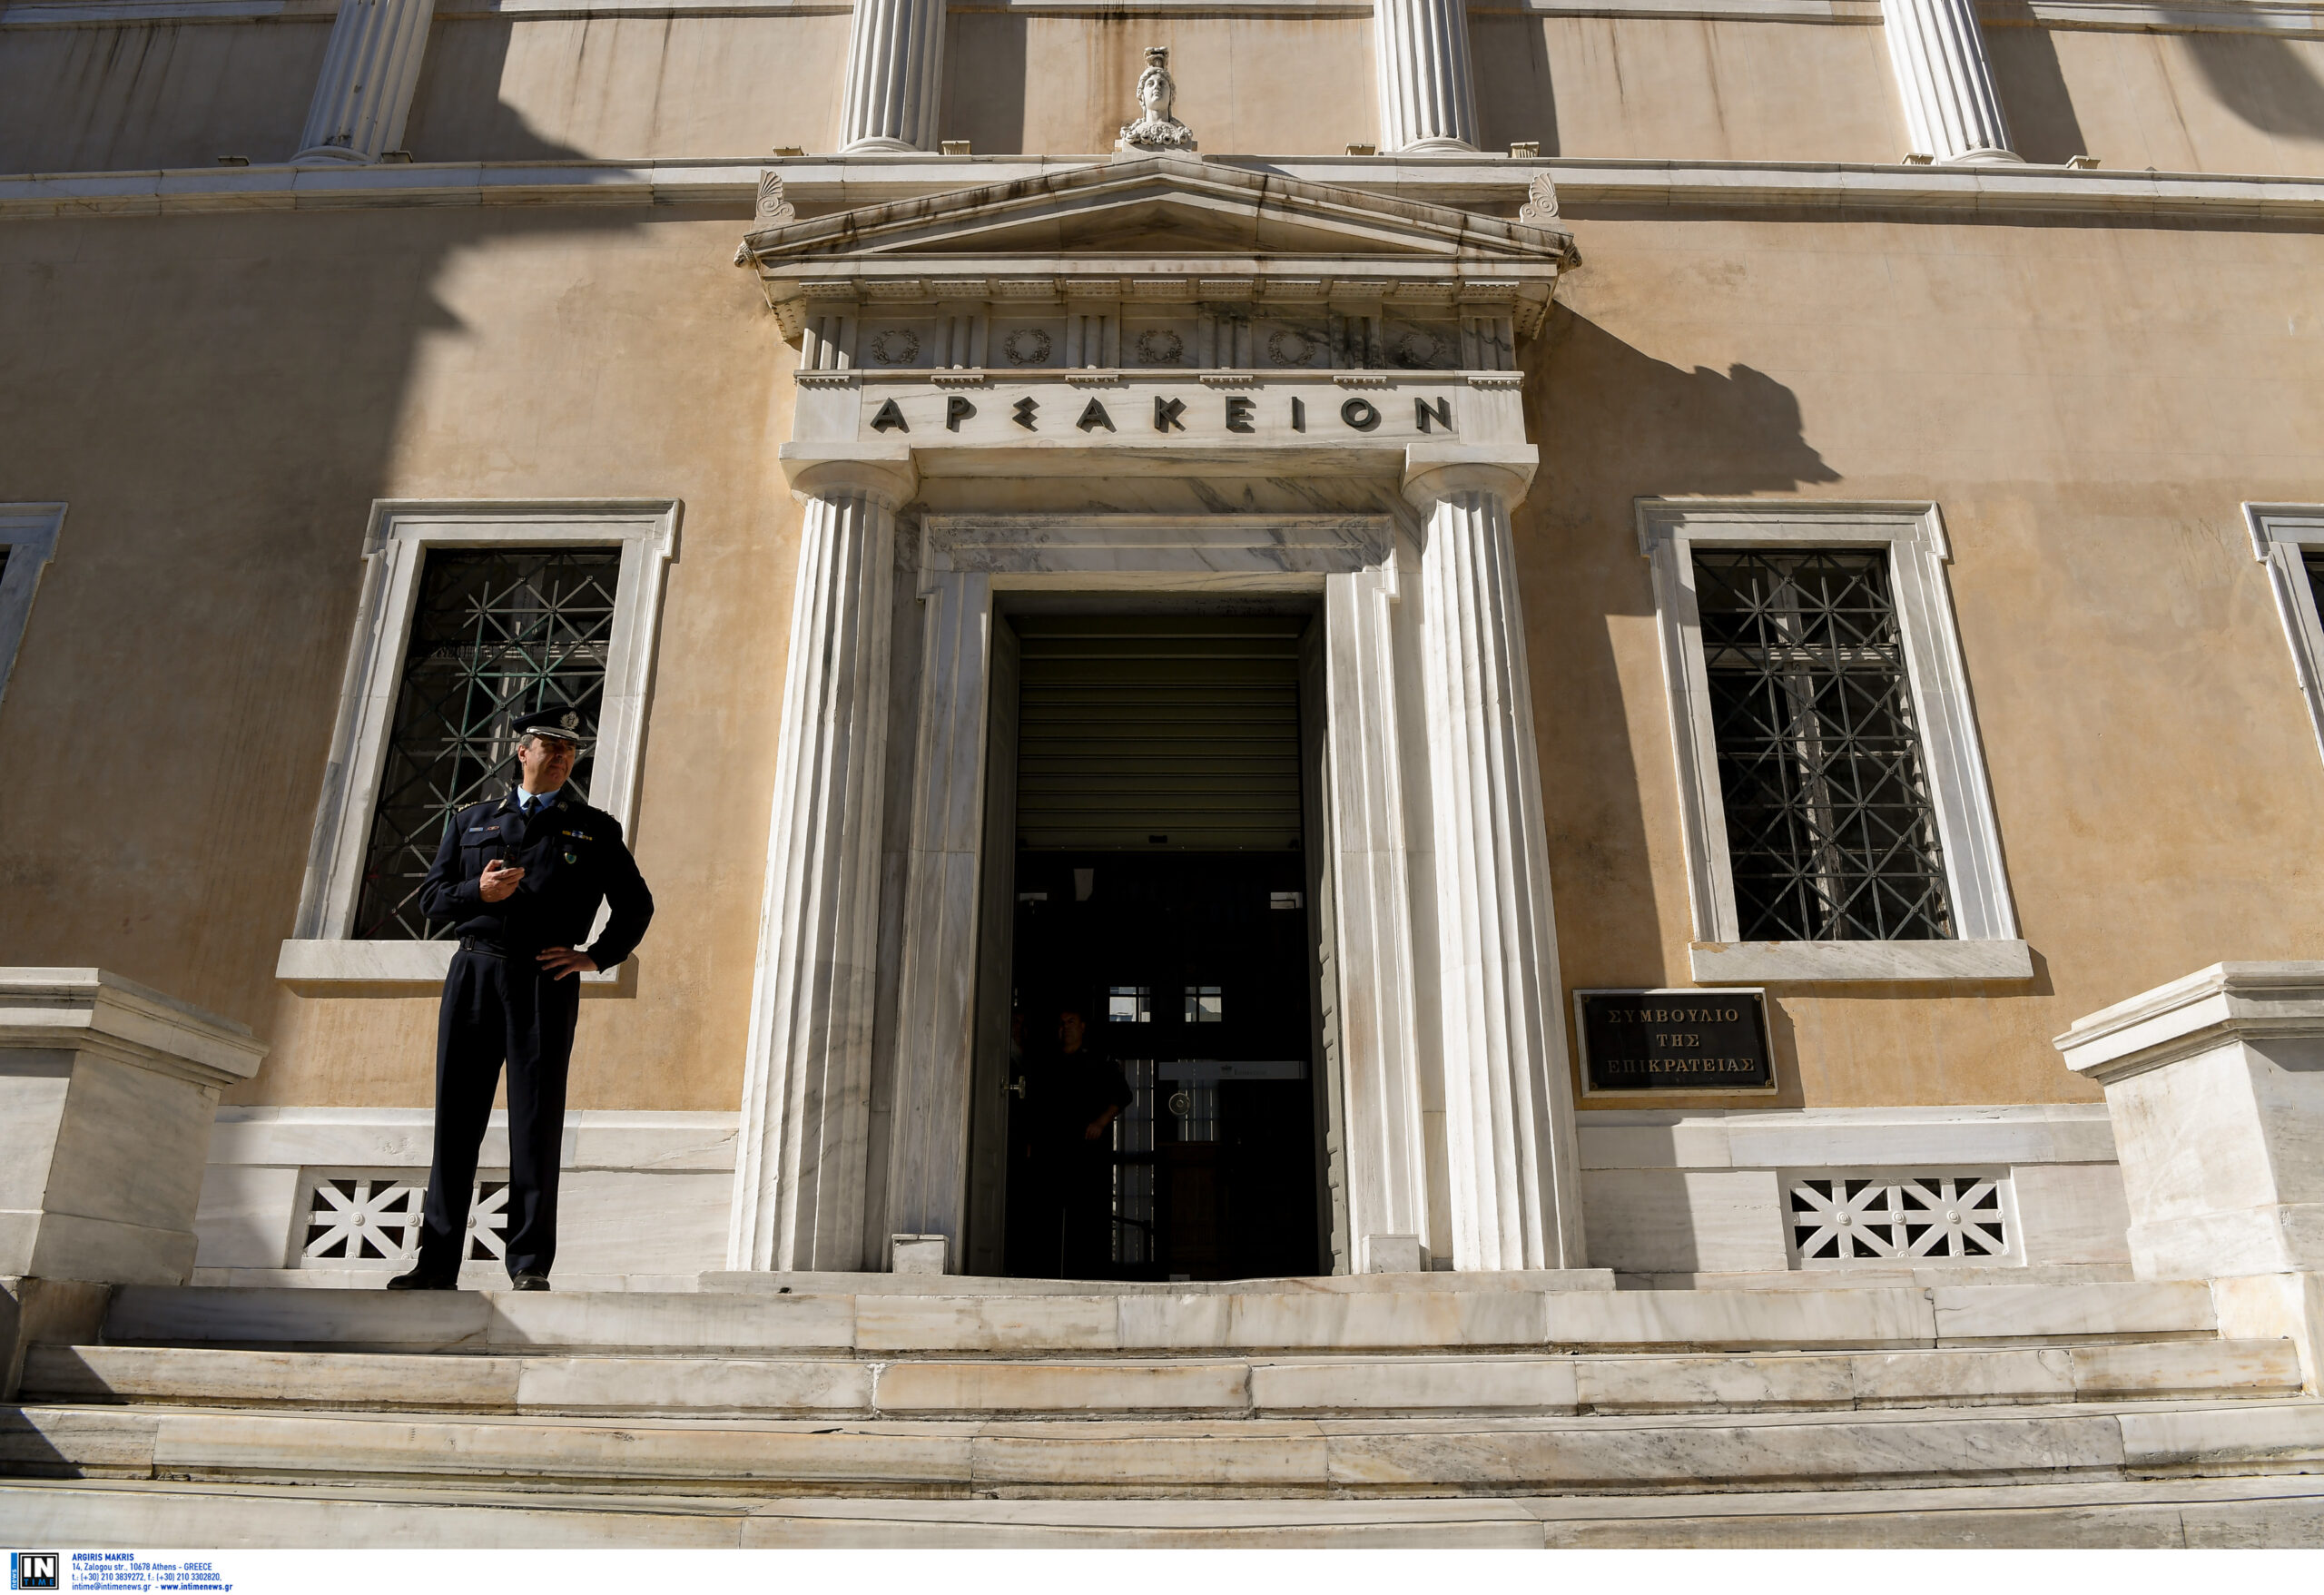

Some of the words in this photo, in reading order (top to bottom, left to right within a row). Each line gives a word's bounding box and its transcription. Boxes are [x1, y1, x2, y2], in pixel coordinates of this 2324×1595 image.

[869, 395, 1451, 433] ΑΡΣΑΚΕΙΟΝ
[1608, 1009, 1738, 1023] ΣΥΜΒΟΥΛΙΟ
[1656, 1033, 1699, 1047] ΤΗΣ
[1608, 1058, 1755, 1073] ΕΠΙΚΡΑΤΕΙΑΣ
